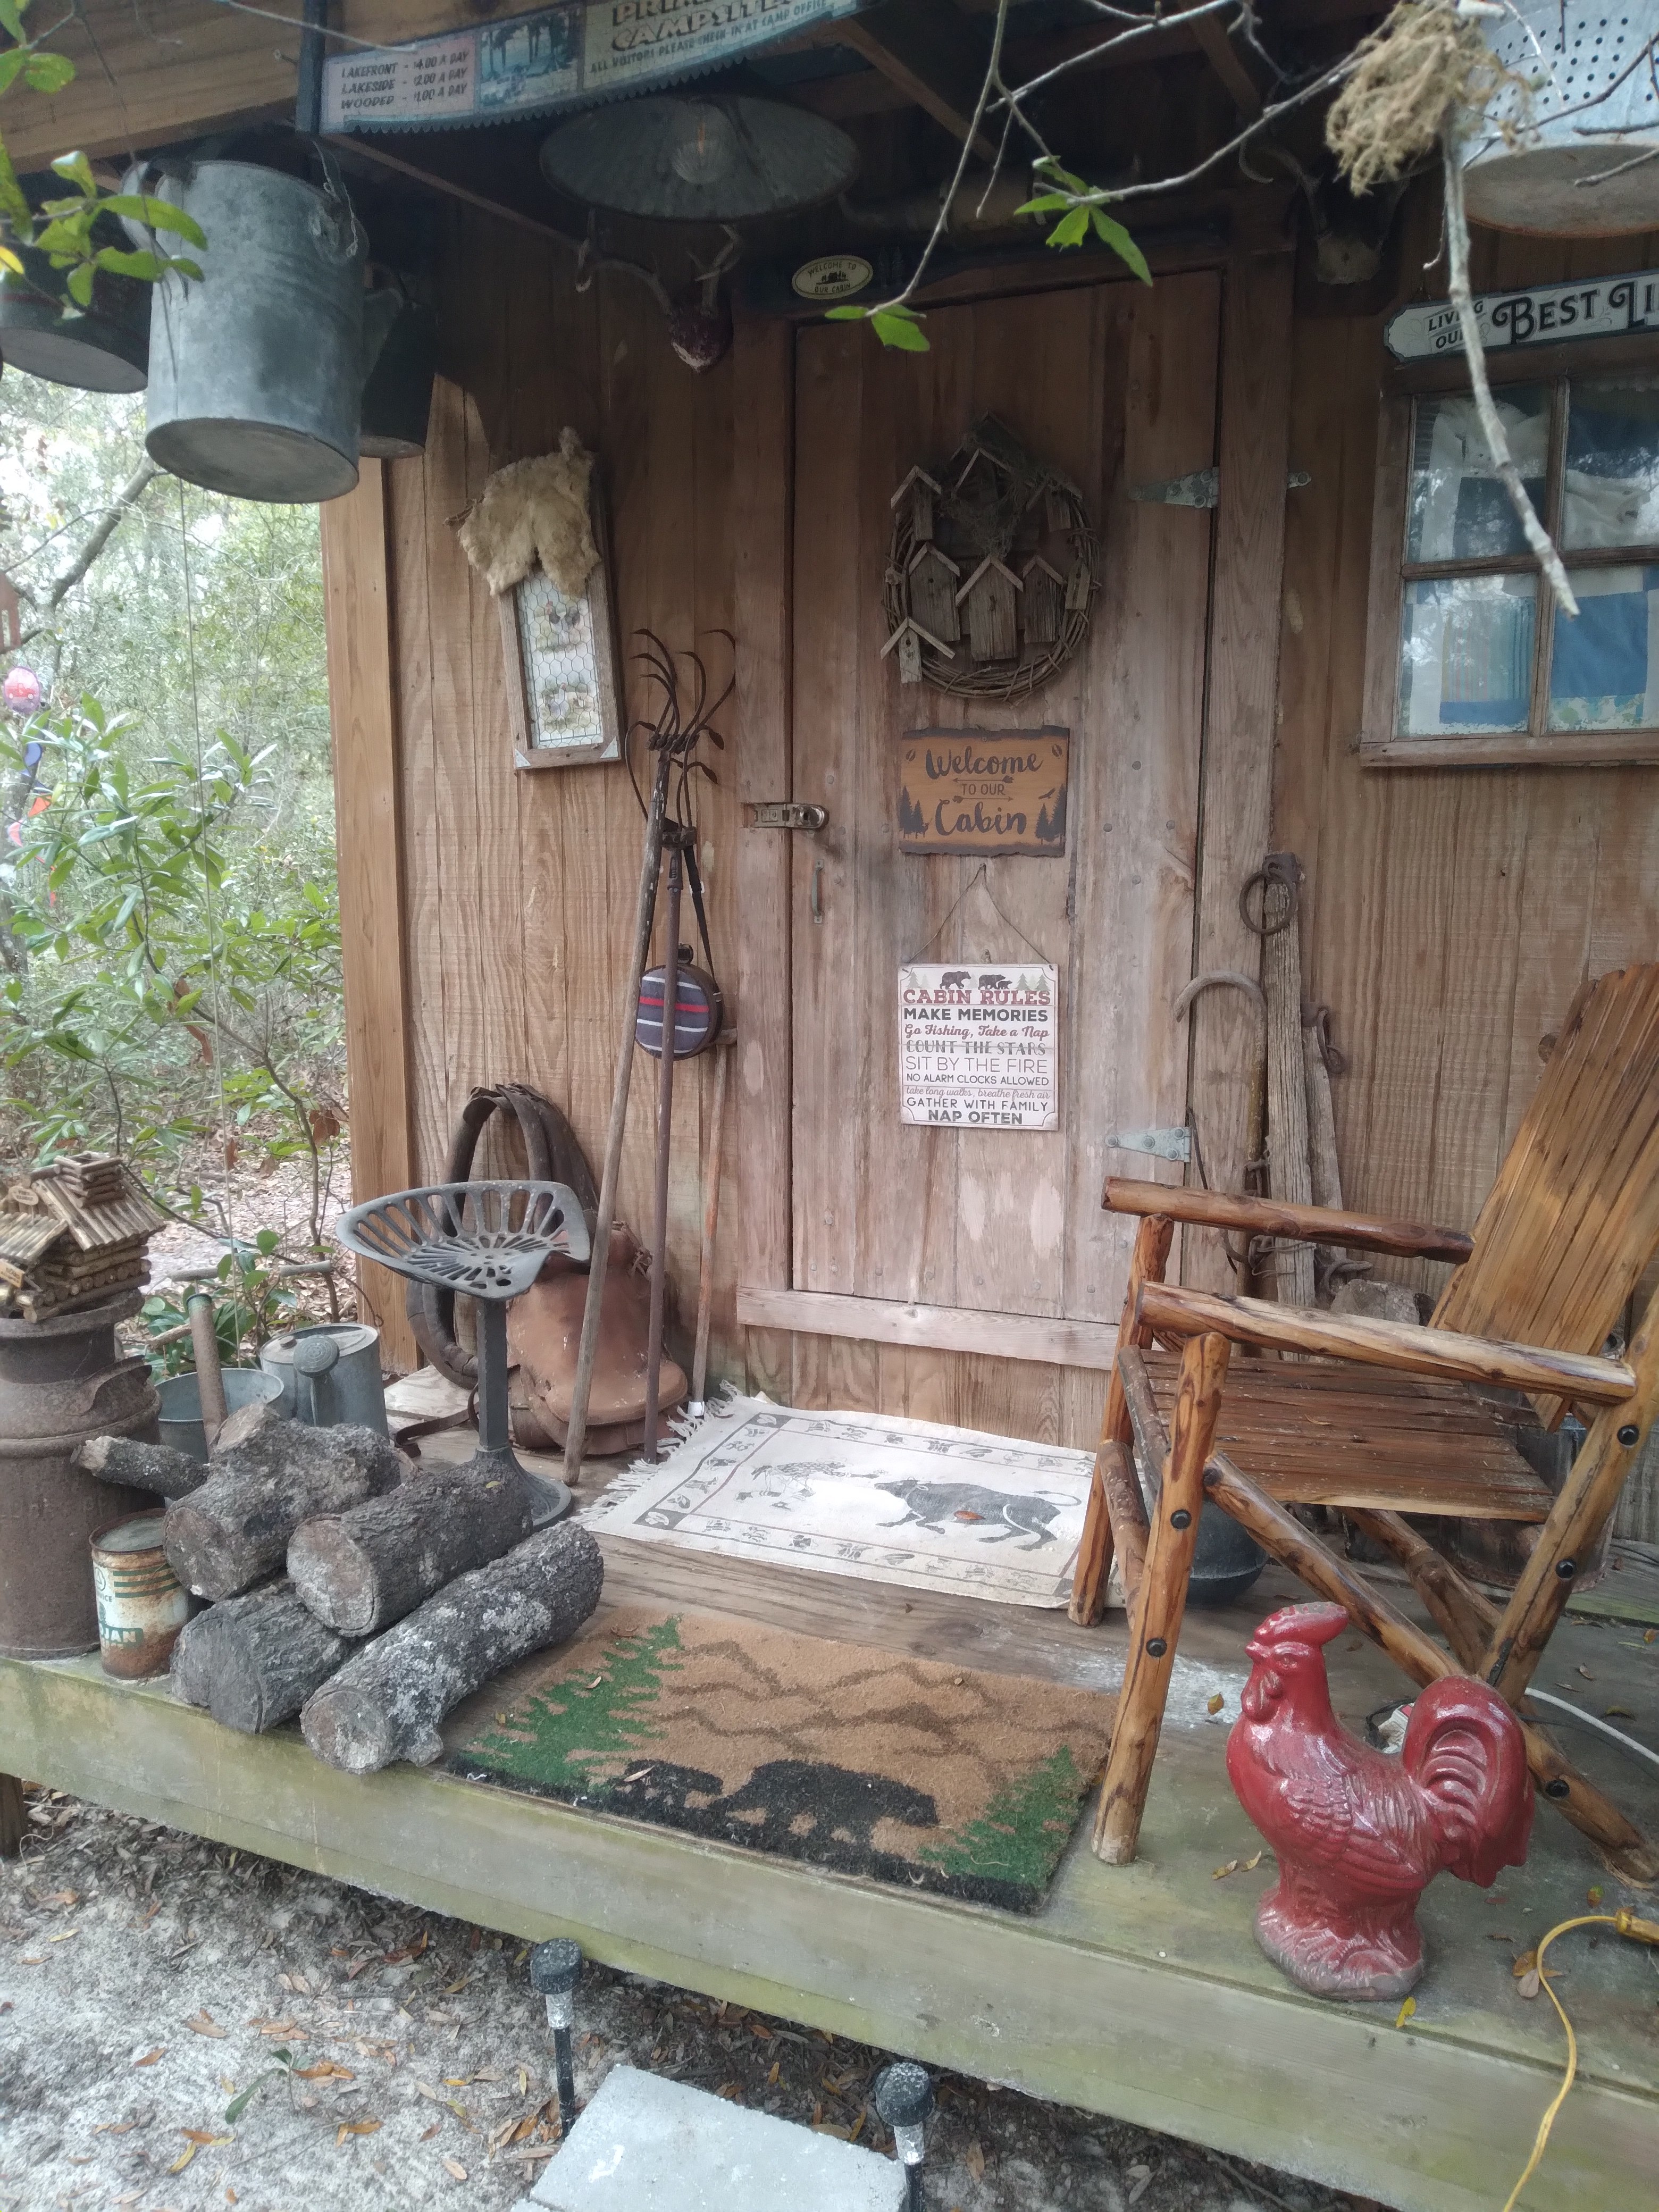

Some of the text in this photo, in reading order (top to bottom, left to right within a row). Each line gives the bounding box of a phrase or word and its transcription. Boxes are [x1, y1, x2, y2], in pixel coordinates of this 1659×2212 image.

[612, 0, 791, 52] CAMPSITE
[591, 60, 608, 73] ALL
[745, 19, 758, 32] AT
[342, 62, 398, 78] LAKEFRONT
[440, 54, 447, 66] A
[450, 51, 469, 65] DAY
[341, 79, 396, 95] LAKESIDE
[438, 72, 445, 83] A
[448, 67, 468, 80] DAY
[341, 95, 395, 109] WOODED
[438, 86, 445, 97] A
[448, 82, 468, 96] DAY
[808, 261, 842, 278] WELCOME
[832, 283, 851, 292] CABIN
[1492, 280, 1659, 345] BEST LI
[925, 745, 1044, 780] Welcome
[961, 783, 1006, 795] TO OUR
[935, 798, 1027, 836] Cabin
[903, 989, 1051, 1005] CABIN RULES
[904, 1008, 1048, 1022] MAKE MEMORIES
[904, 1024, 923, 1038] Go
[925, 1025, 974, 1040] Fishing,
[978, 1025, 1007, 1036] Take
[1021, 1026, 1050, 1042] Nap
[906, 1040, 1045, 1056] COUNT THE STARS
[906, 1055, 1048, 1074] SIT BY THE FIRE
[907, 1073, 1049, 1086] NO ALARM CLOCKS ALLOWED
[907, 1086, 924, 1095] take
[925, 1086, 945, 1099] long
[946, 1088, 975, 1099] walks,
[978, 1088, 1010, 1098] breathe
[1011, 1090, 1035, 1102] fresh
[907, 1097, 1048, 1111] GATHER WITH FAMILY
[928, 1110, 1023, 1125] NAP OFTEN
